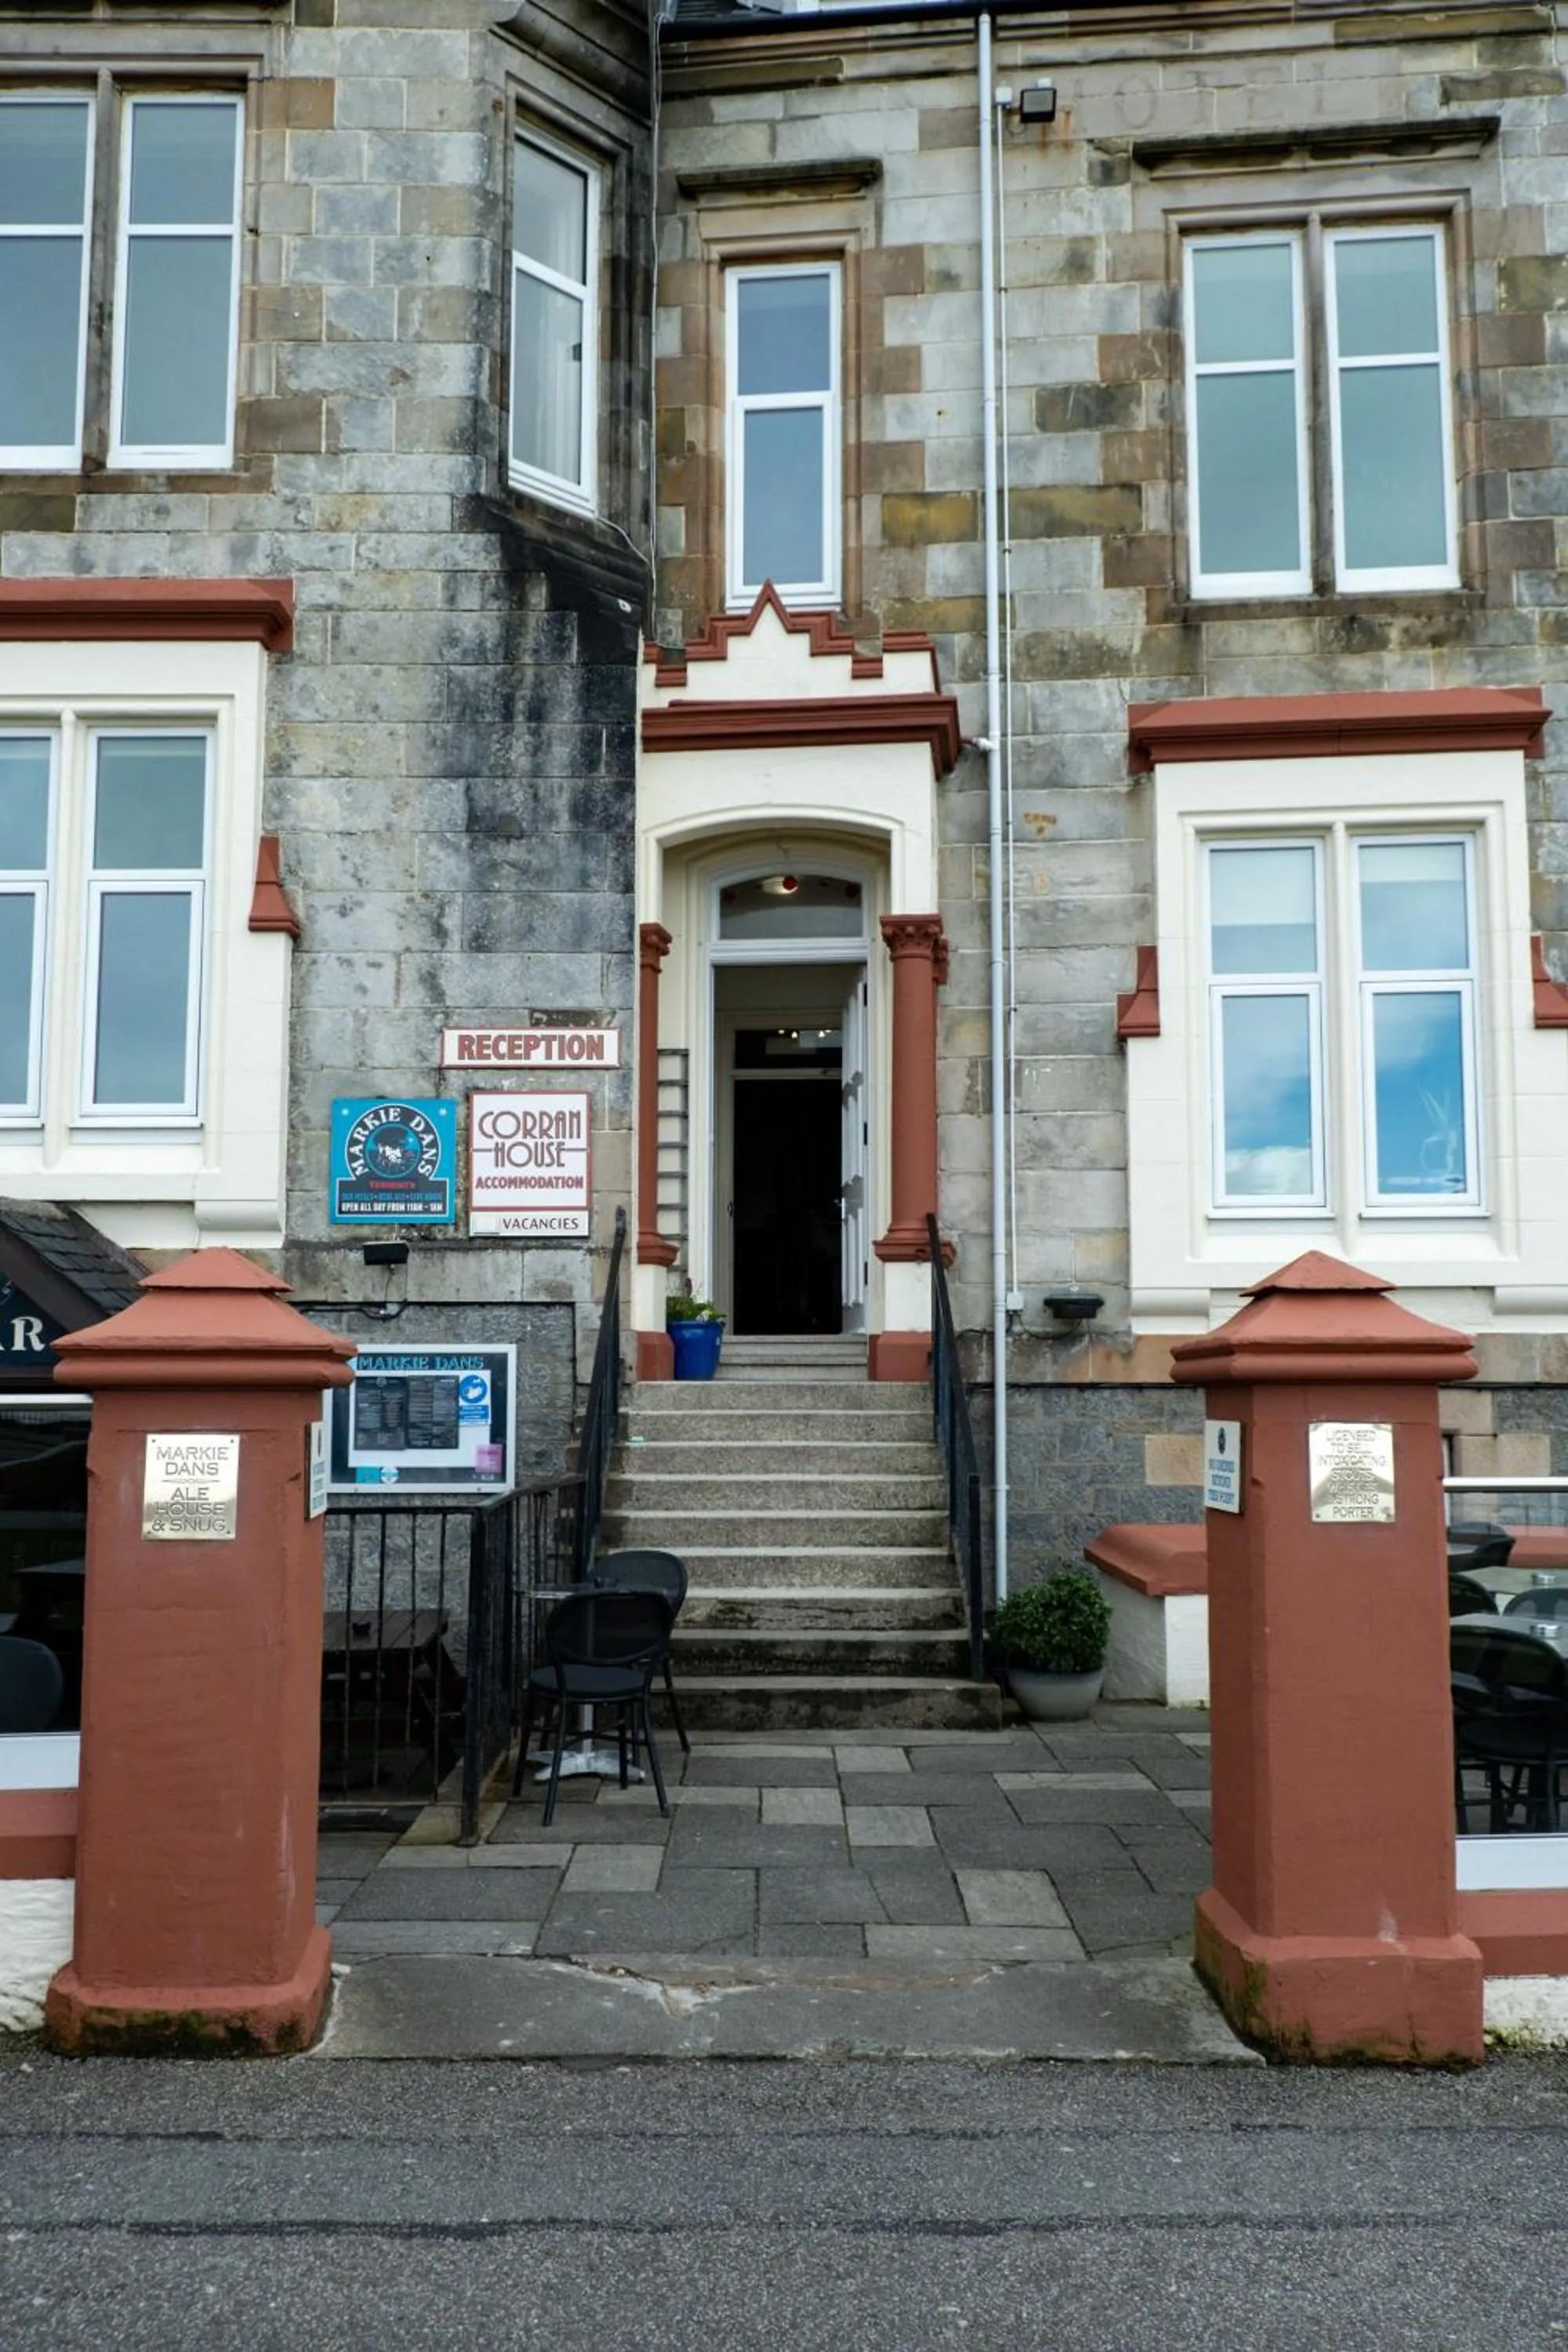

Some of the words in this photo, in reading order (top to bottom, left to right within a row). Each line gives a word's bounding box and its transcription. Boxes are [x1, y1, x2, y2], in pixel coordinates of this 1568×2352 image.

[456, 1034, 604, 1061] RECEPTION
[477, 1111, 582, 1140] CORRAN
[349, 1107, 401, 1176] MARKIE
[409, 1115, 437, 1176] DANS
[494, 1142, 565, 1168] HOUSE
[475, 1175, 584, 1189] ACCOMMODATION
[341, 1202, 358, 1211] OPEN
[387, 1202, 405, 1211] FROM
[502, 1218, 579, 1230] VACANCIES
[358, 1356, 430, 1370] MARKIE
[434, 1356, 485, 1370] DANS
[1326, 1429, 1377, 1442] LICENSED
[155, 1446, 230, 1461] MARKIE
[1330, 1442, 1344, 1454] TO
[165, 1462, 220, 1476] DANS
[170, 1487, 210, 1501] ALE
[155, 1502, 226, 1516] HOUSE
[1332, 1506, 1375, 1519] PORTER
[151, 1519, 165, 1532] &
[169, 1518, 227, 1532] SNUG
